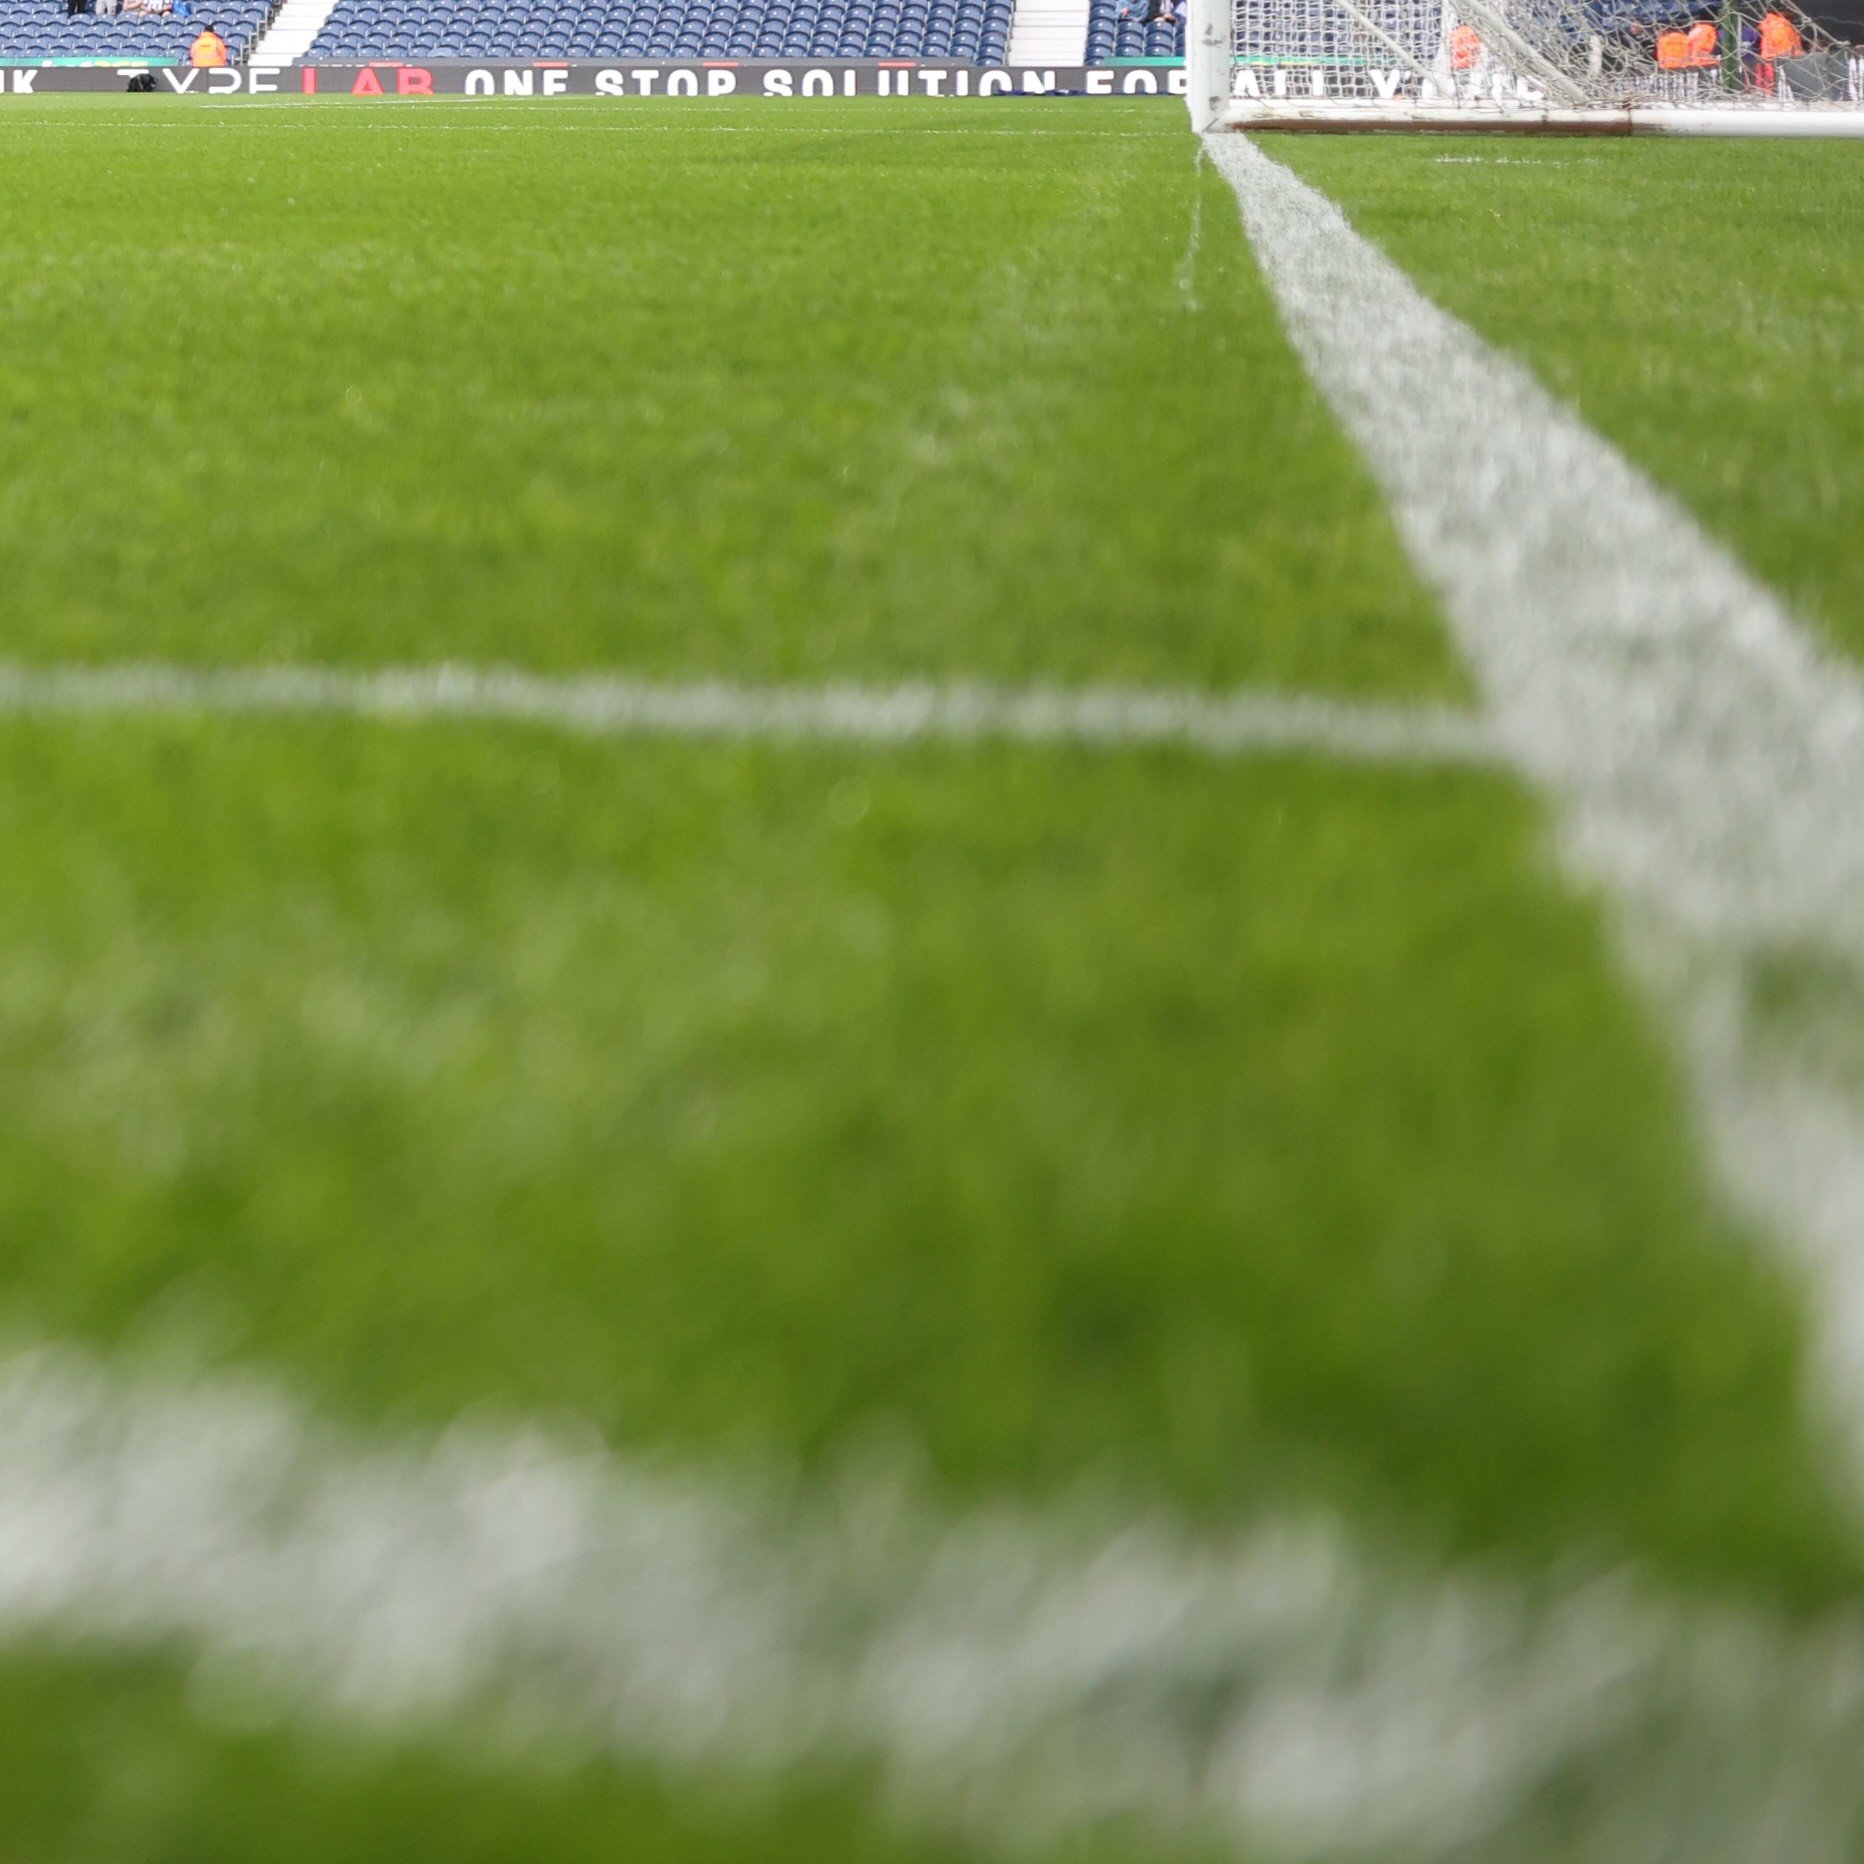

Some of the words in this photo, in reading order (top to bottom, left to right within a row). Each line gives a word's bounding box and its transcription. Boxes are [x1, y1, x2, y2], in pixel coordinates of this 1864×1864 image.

[465, 70, 569, 95] ONE
[595, 69, 737, 96] STOP
[762, 69, 1056, 97] SOLUTION
